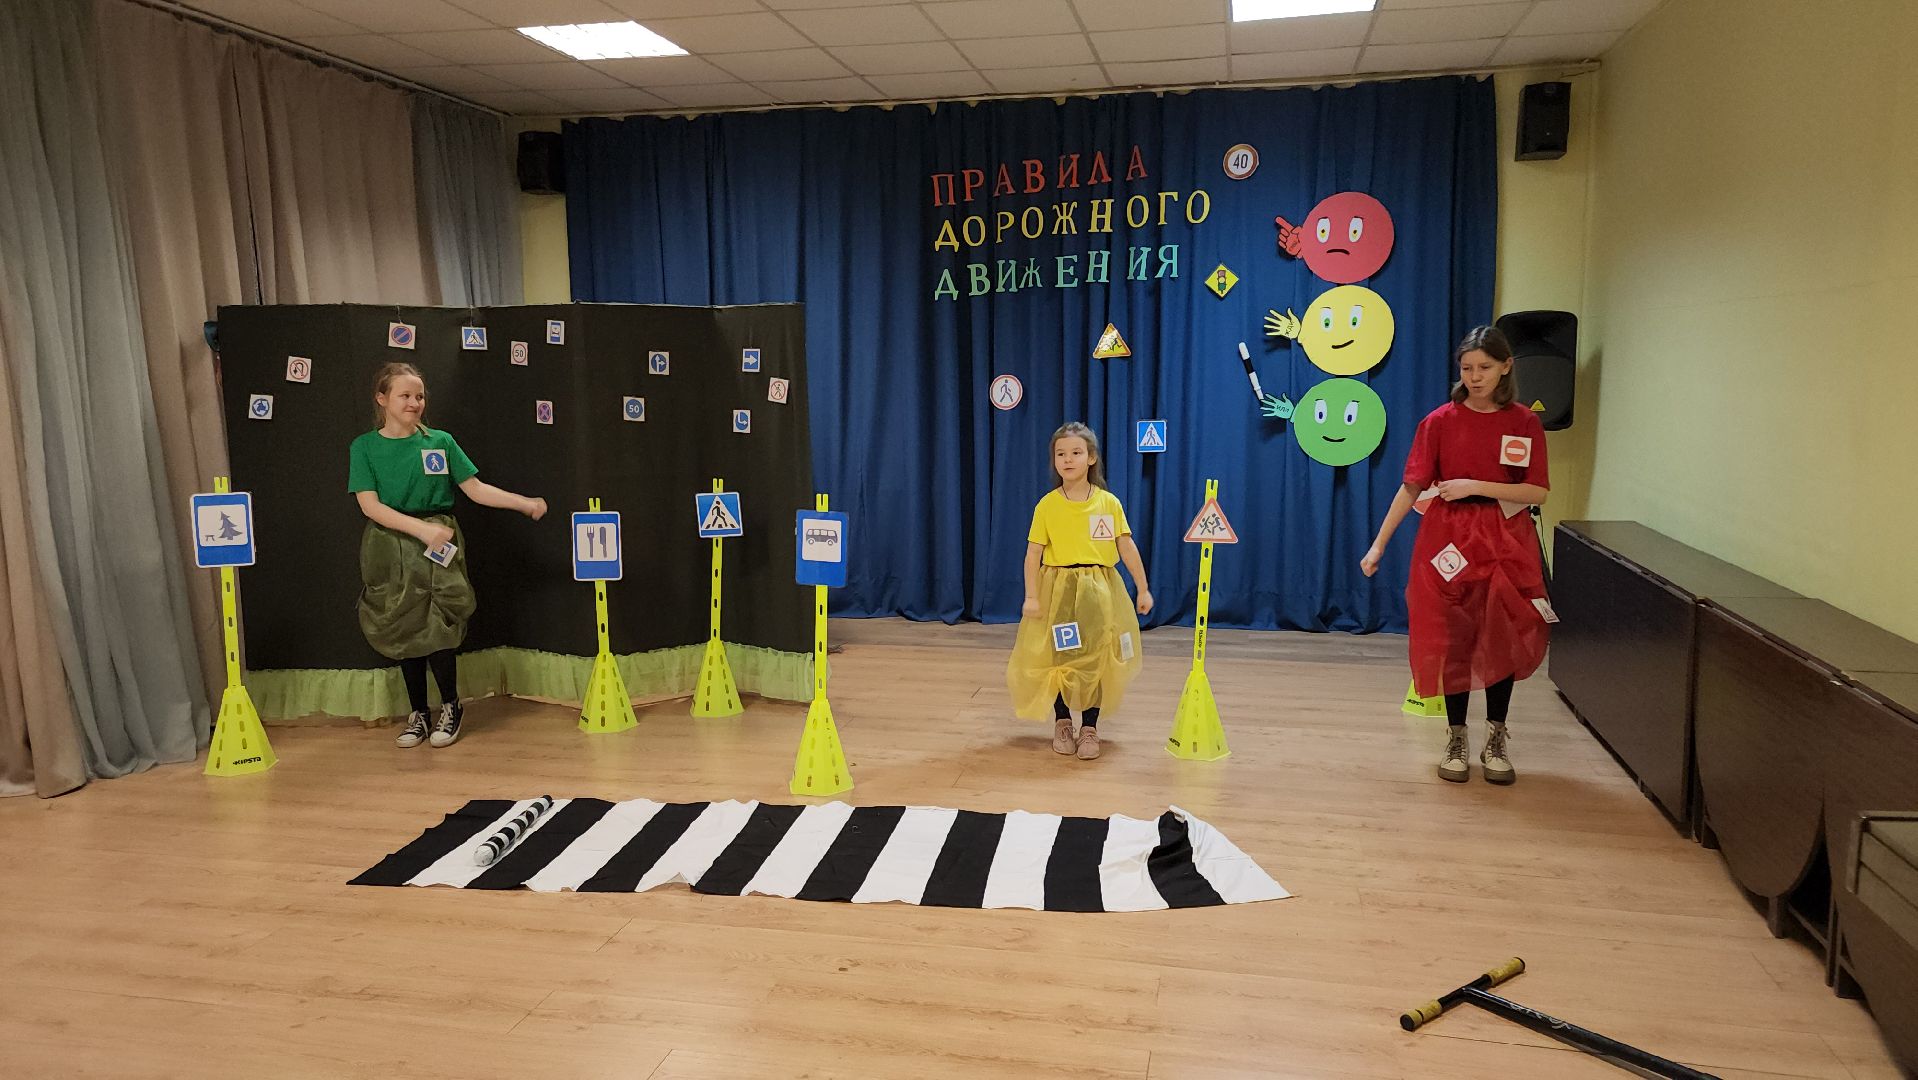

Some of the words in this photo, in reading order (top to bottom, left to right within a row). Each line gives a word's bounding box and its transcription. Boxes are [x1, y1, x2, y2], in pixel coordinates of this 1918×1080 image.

[931, 145, 1148, 207] ПРАВИЛА
[1232, 153, 1249, 170] 40
[934, 189, 1211, 252] ДОРОЖНОГО
[934, 244, 1180, 301] ДВИЖЕНИЯ
[514, 350, 524, 358] 50
[628, 404, 640, 413] 50
